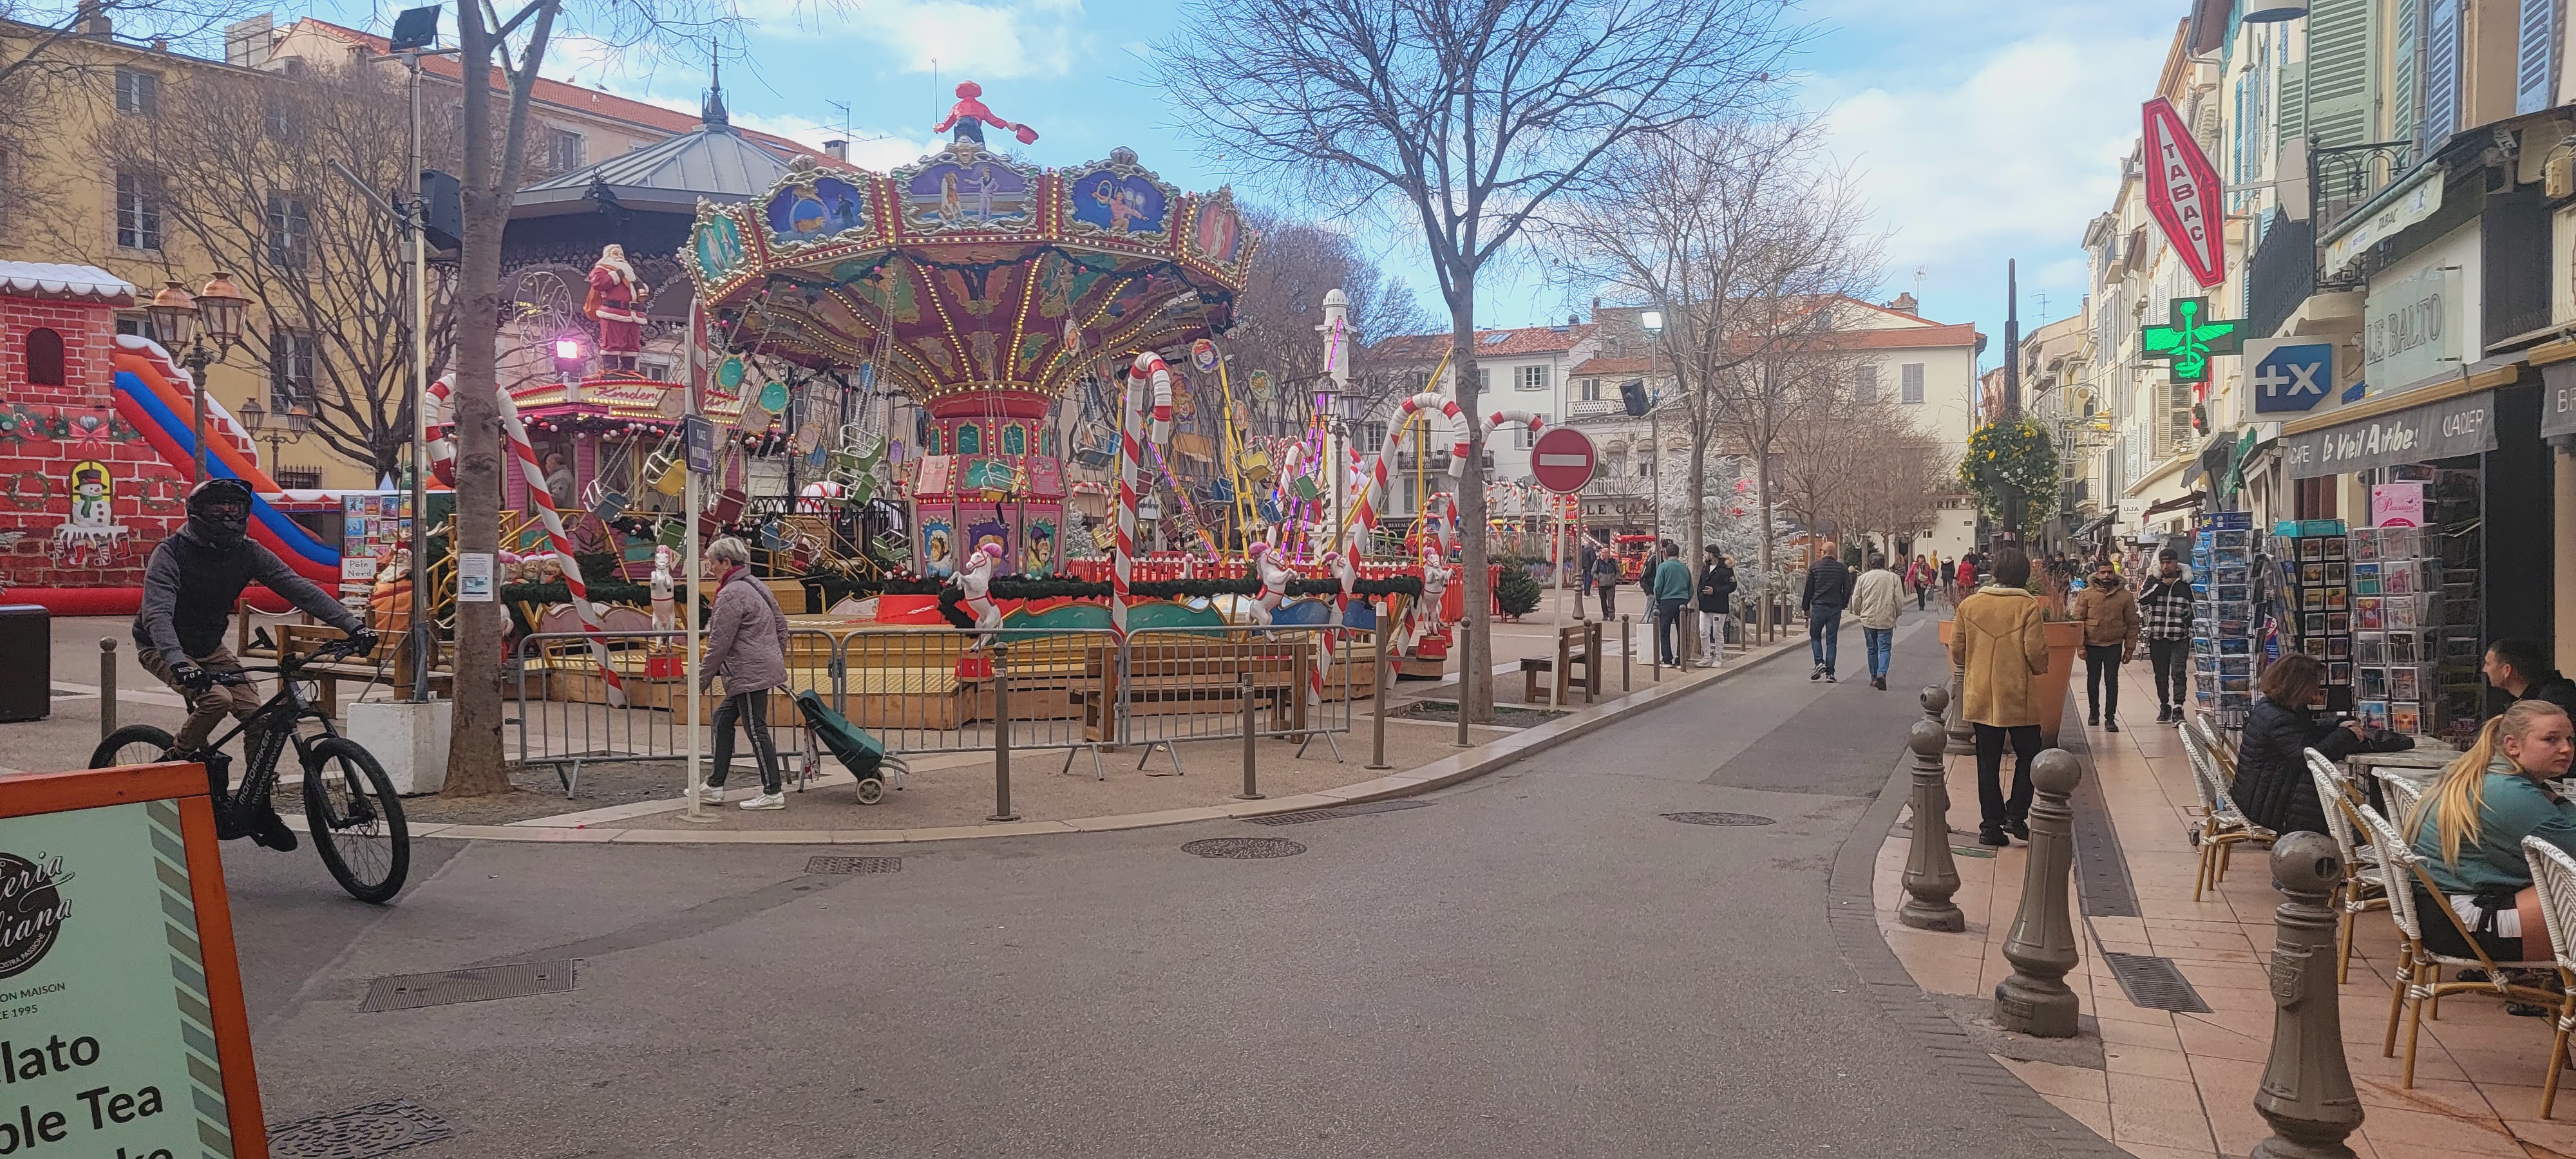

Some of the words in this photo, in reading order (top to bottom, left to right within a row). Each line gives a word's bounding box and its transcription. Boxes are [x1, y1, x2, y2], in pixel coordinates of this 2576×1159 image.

[2163, 143, 2204, 242] TABAC
[2366, 319, 2384, 367] LE
[2388, 293, 2442, 358] BALTO
[2336, 429, 2365, 460] Vieil
[2365, 420, 2419, 456] Atibe
[1586, 504, 1606, 514] LE
[183, 670, 202, 681] FOX
[20, 932, 46, 960] PASSIONE
[20, 981, 66, 999] MAISON
[12, 1004, 38, 1018] 1995
[0, 1034, 100, 1085] lato
[76, 1086, 164, 1130] Tea
